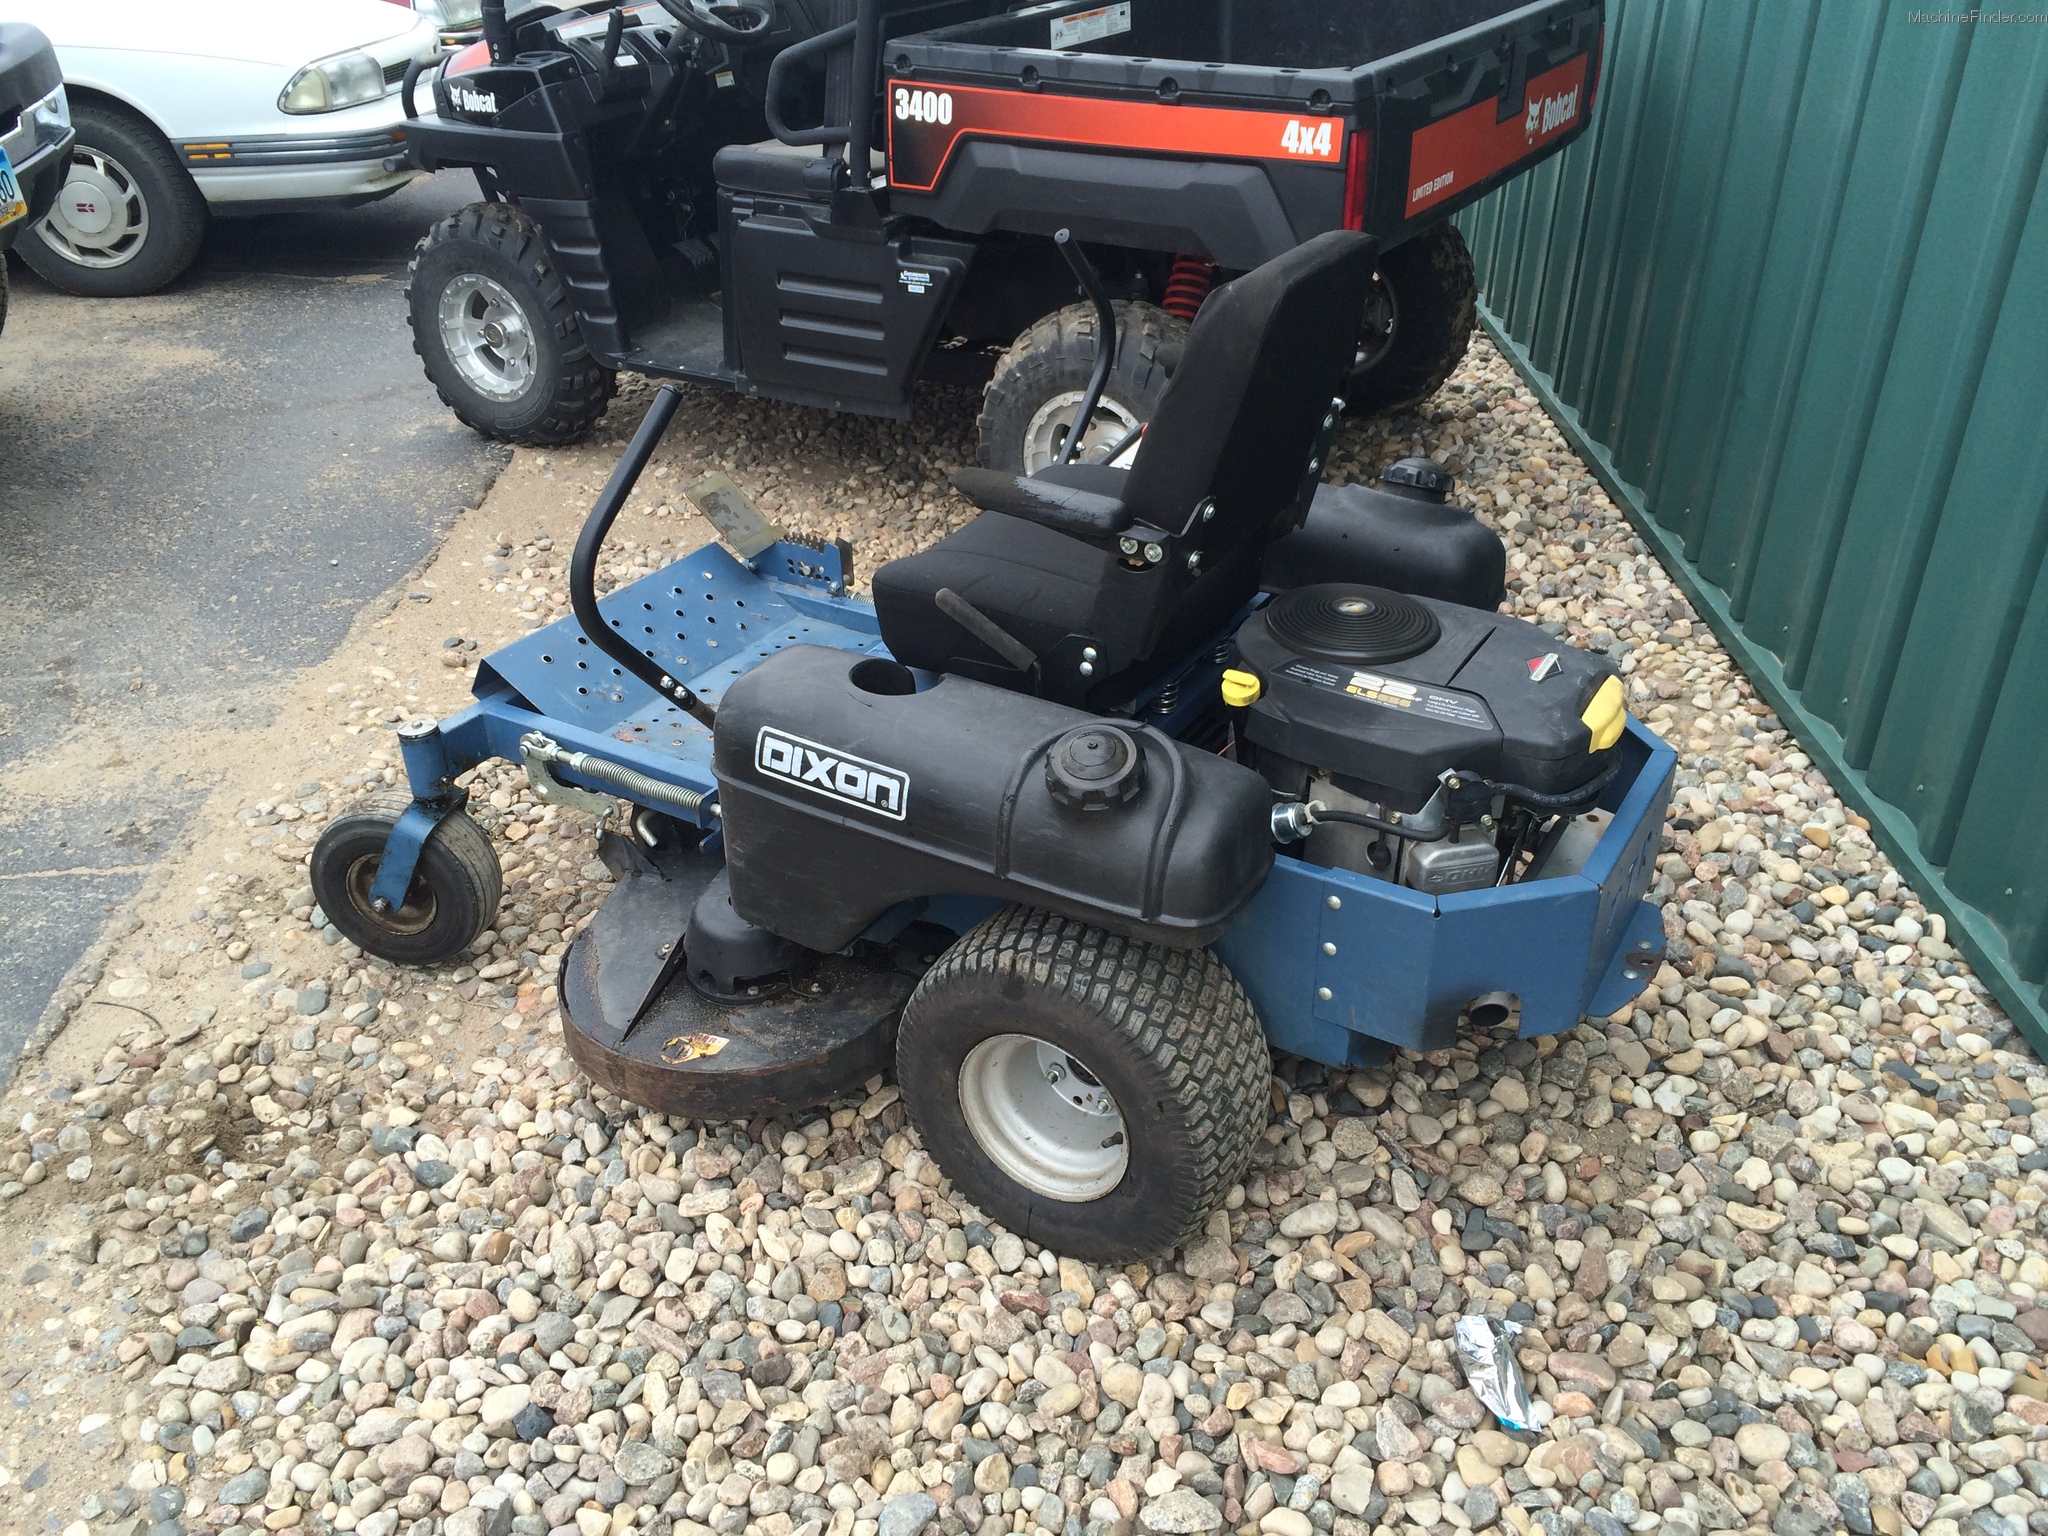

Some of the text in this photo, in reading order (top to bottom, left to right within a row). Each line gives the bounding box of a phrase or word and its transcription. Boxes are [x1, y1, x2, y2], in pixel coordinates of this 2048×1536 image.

[462, 89, 497, 114] Bobcat
[895, 88, 953, 125] 3400
[1541, 84, 1578, 134] Bobcat
[1281, 119, 1332, 156] 4x4
[1412, 170, 1455, 202] LIMITED EDITION
[1349, 671, 1418, 701] 22
[1429, 694, 1459, 705] OHV
